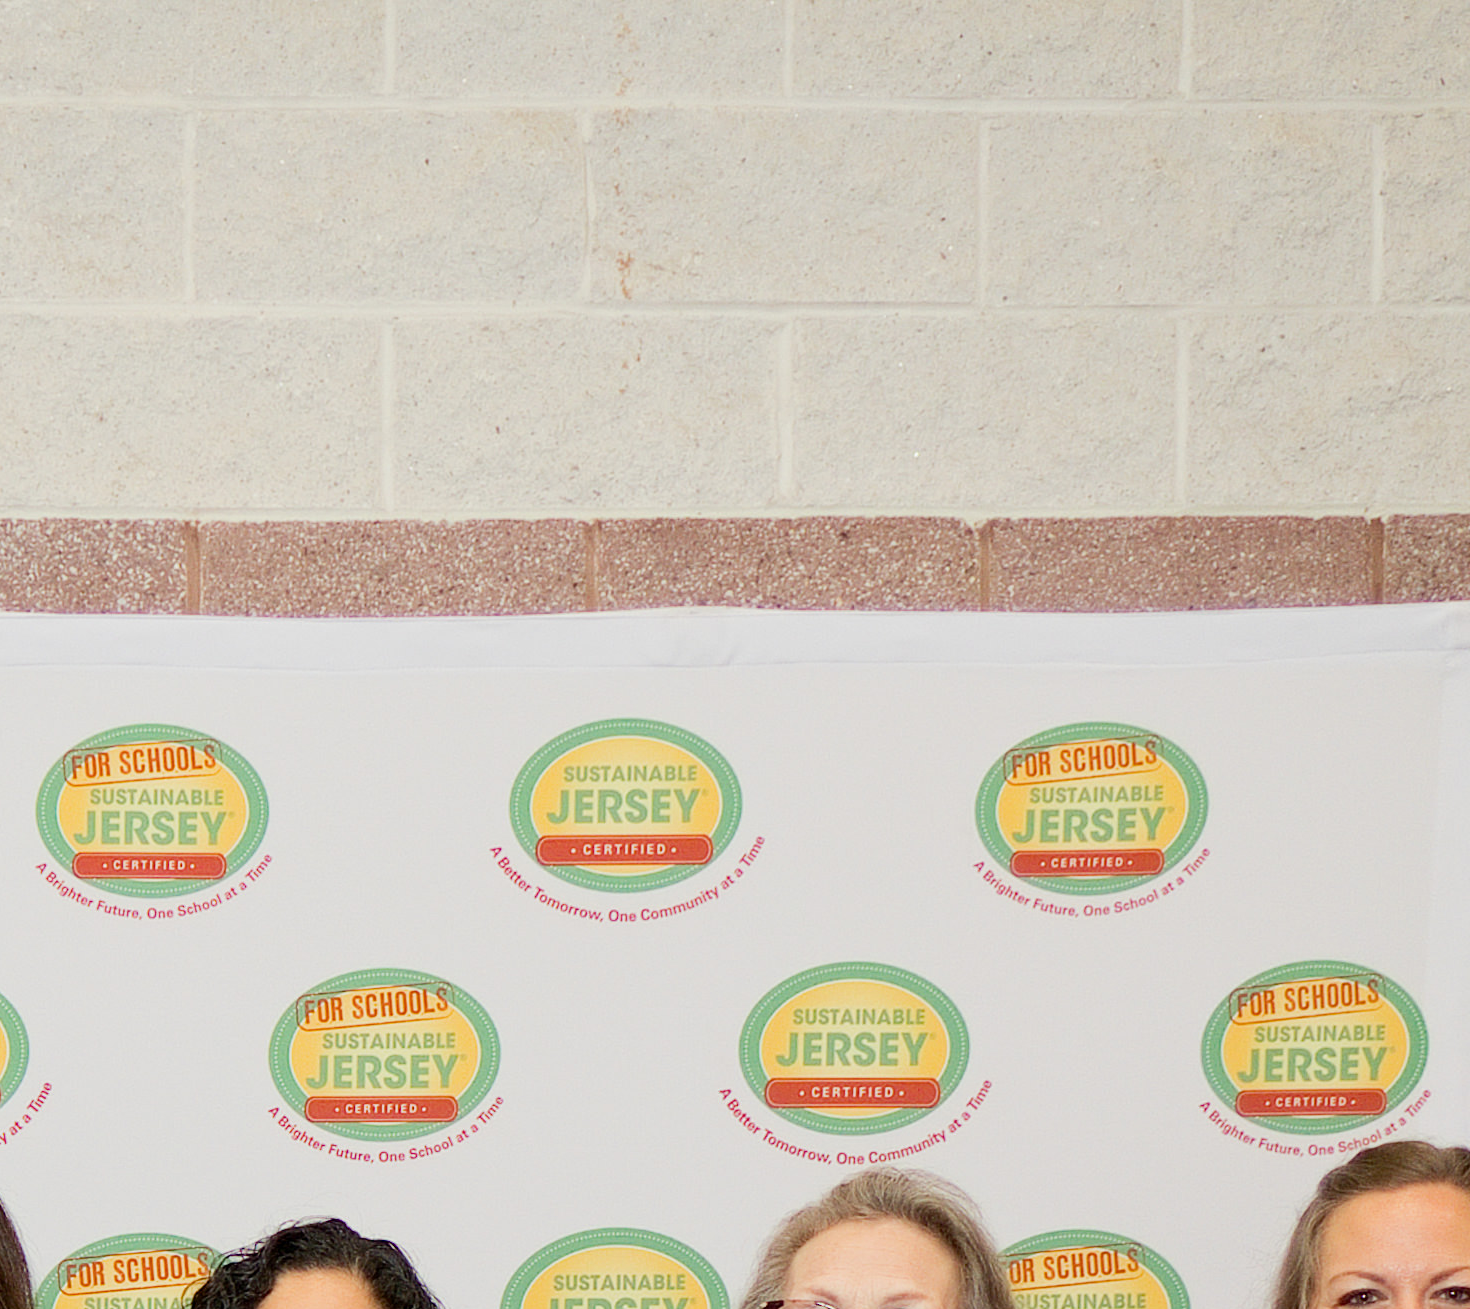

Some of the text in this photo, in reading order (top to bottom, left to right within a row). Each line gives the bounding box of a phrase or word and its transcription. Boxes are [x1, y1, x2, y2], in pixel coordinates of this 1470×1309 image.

[71, 744, 216, 779] FOR SCHOOLS
[1012, 742, 1157, 778] FOR SCHOOLS
[563, 765, 697, 782] SUSTAINABLE
[90, 789, 224, 806] SUSTAINABLE
[1029, 787, 1163, 803] SUSTAINABLE
[546, 789, 700, 824] JERSEY
[74, 811, 227, 845] JERSEY
[1012, 808, 1166, 842] JERSEY
[583, 844, 666, 856] CERTIFIED
[113, 860, 186, 871] CERTIFIED
[1050, 857, 1124, 868] CERTIFIED
